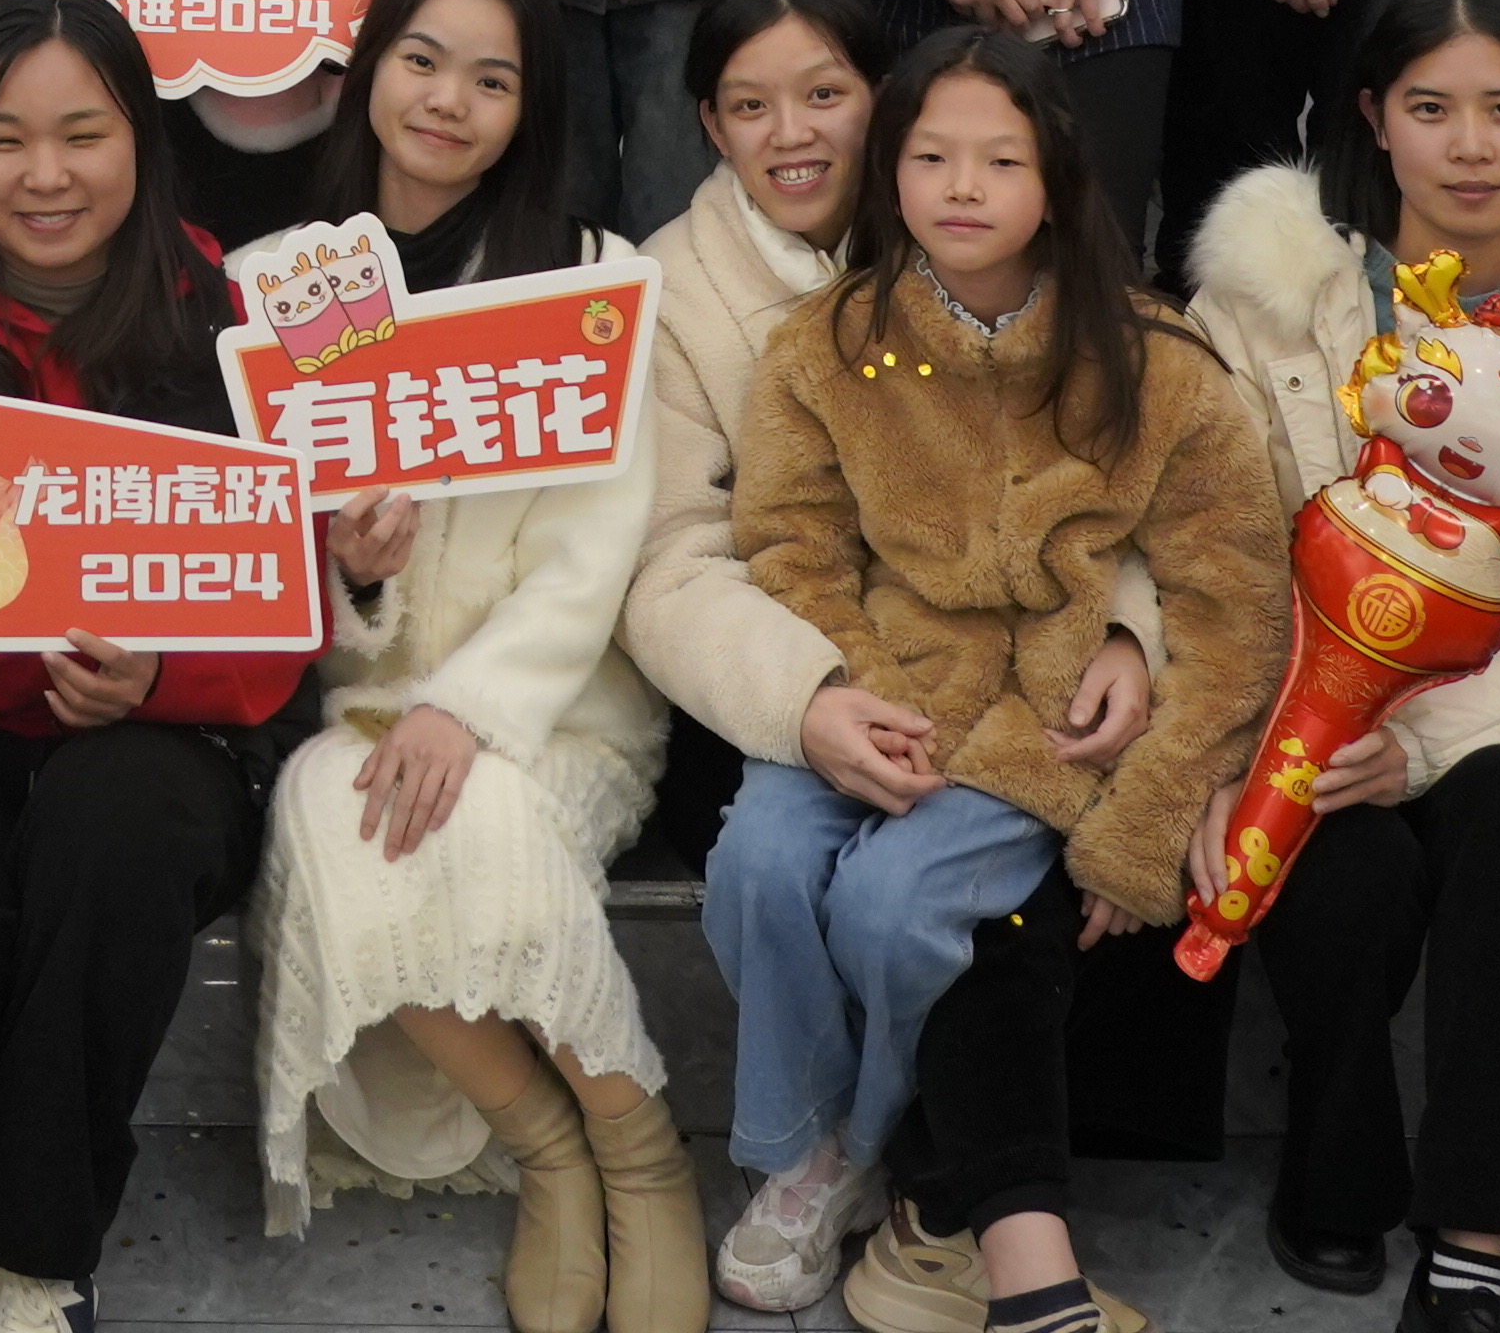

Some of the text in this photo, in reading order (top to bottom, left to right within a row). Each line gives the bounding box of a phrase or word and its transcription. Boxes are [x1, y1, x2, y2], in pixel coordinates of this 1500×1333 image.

[266, 353, 613, 482] 有钱花
[12, 463, 294, 526] 龙腾虎跃
[79, 552, 285, 602] 2024
